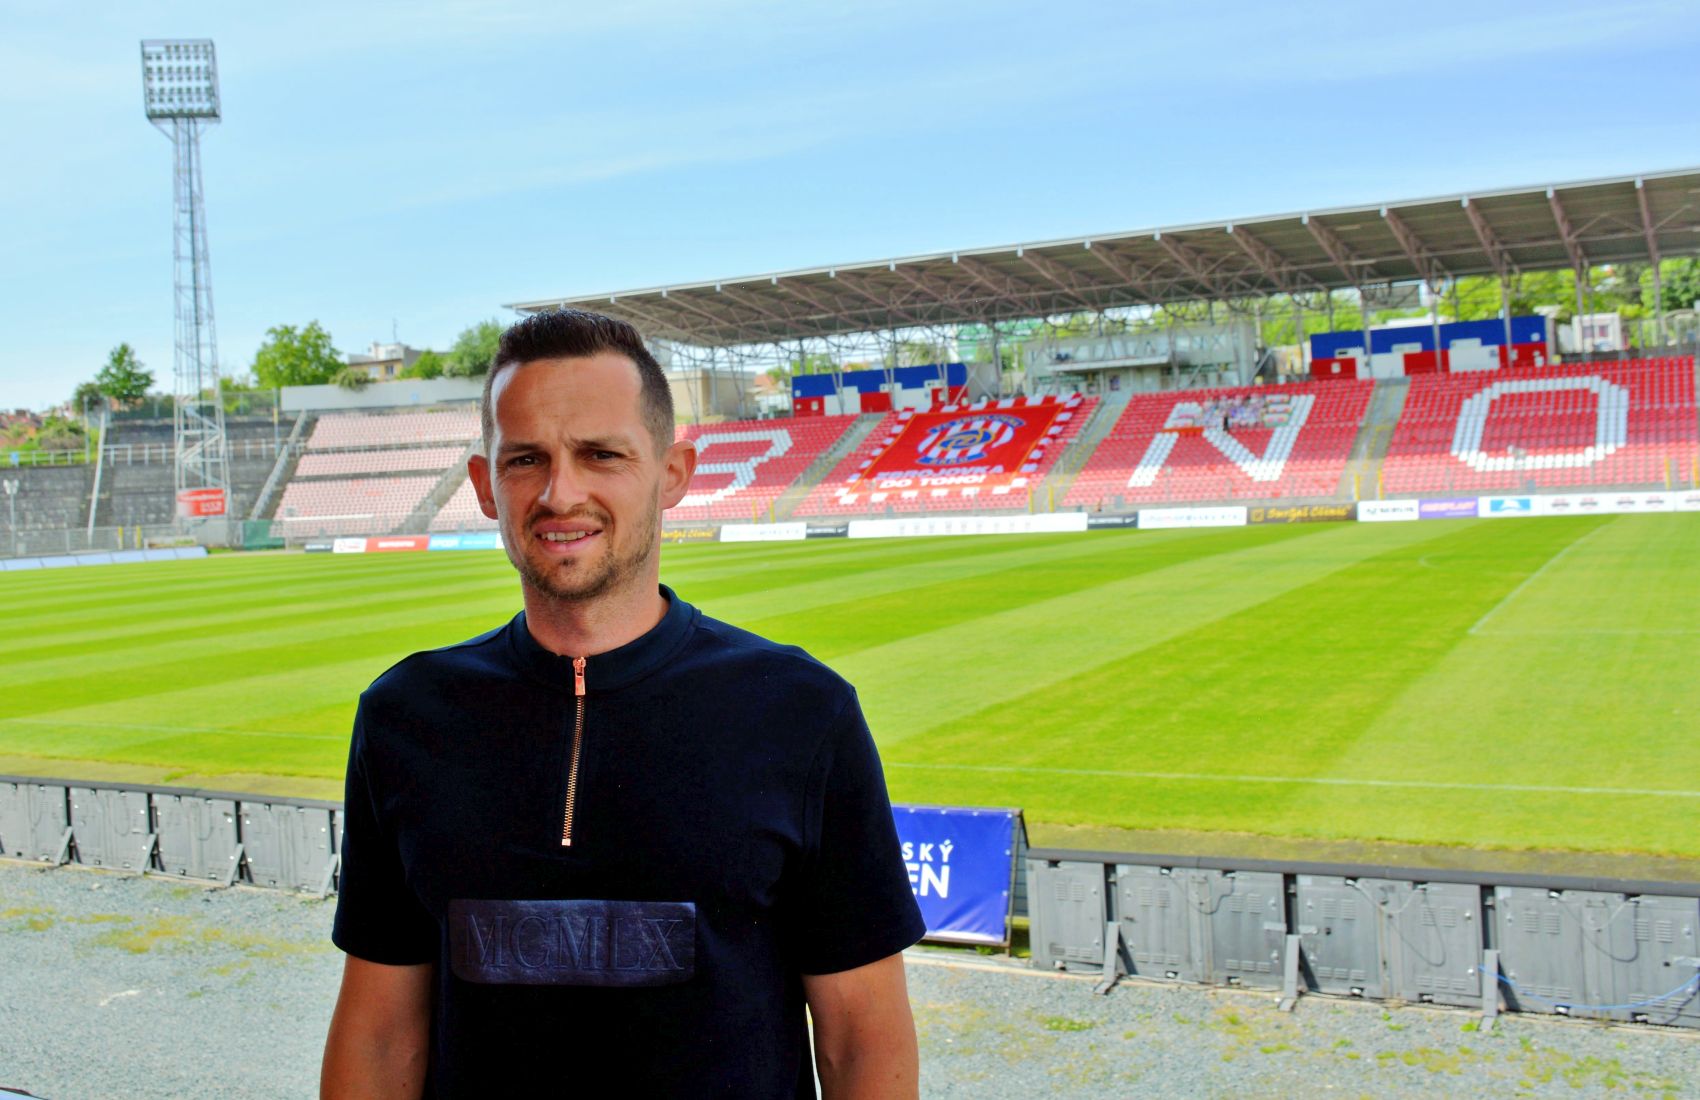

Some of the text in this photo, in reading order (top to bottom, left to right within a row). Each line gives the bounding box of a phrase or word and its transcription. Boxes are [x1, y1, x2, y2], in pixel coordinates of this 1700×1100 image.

[876, 466, 1003, 480] ZBROJOVKA
[880, 475, 986, 489] DO TOHO!
[464, 914, 684, 970] MCMLX
